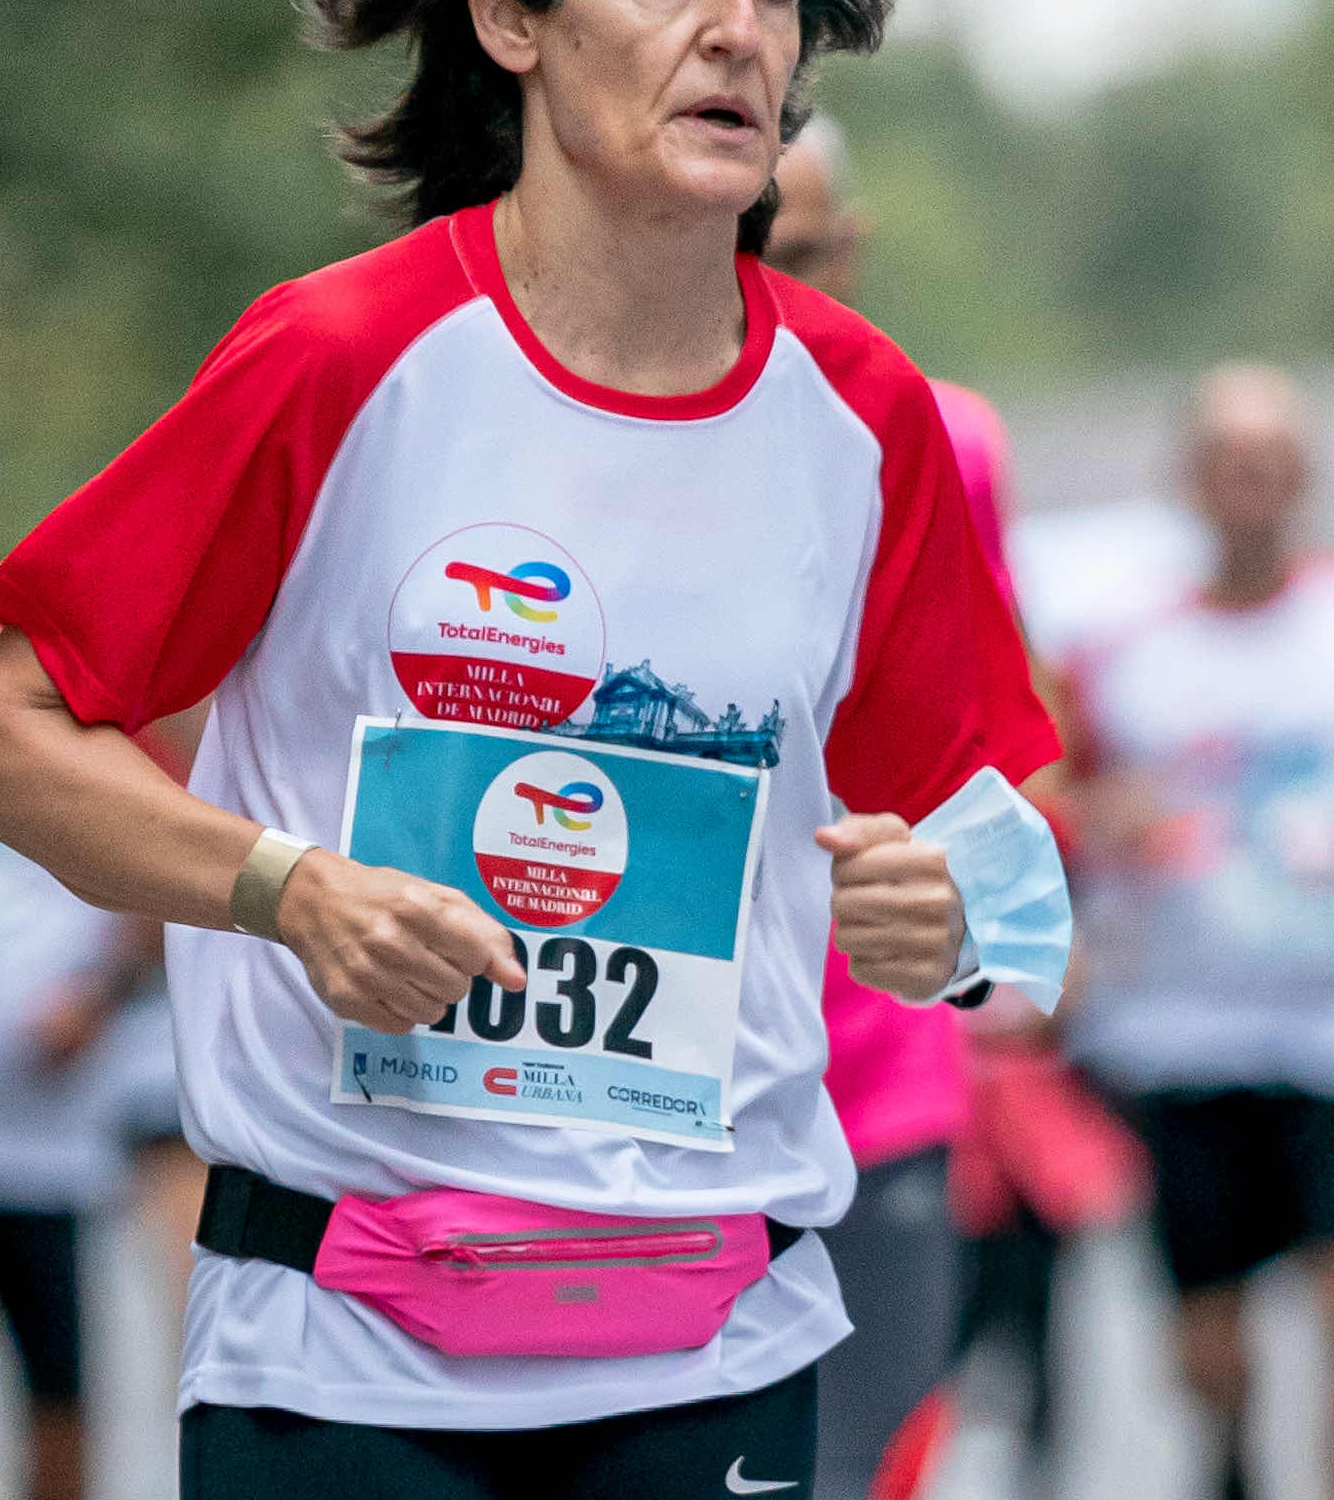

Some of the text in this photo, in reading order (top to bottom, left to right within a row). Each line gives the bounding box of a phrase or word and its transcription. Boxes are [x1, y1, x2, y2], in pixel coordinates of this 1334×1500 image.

[438, 622, 566, 655] TotalEnergies
[467, 664, 525, 687] MILLA
[437, 700, 541, 728] DE MADRID
[508, 831, 596, 857] TotalEnergies
[526, 866, 567, 884] MILLA
[507, 893, 584, 916] DE MADRID
[380, 1057, 459, 1084] MADRID
[522, 1069, 575, 1086] MILLA
[521, 1085, 583, 1104] URBANA
